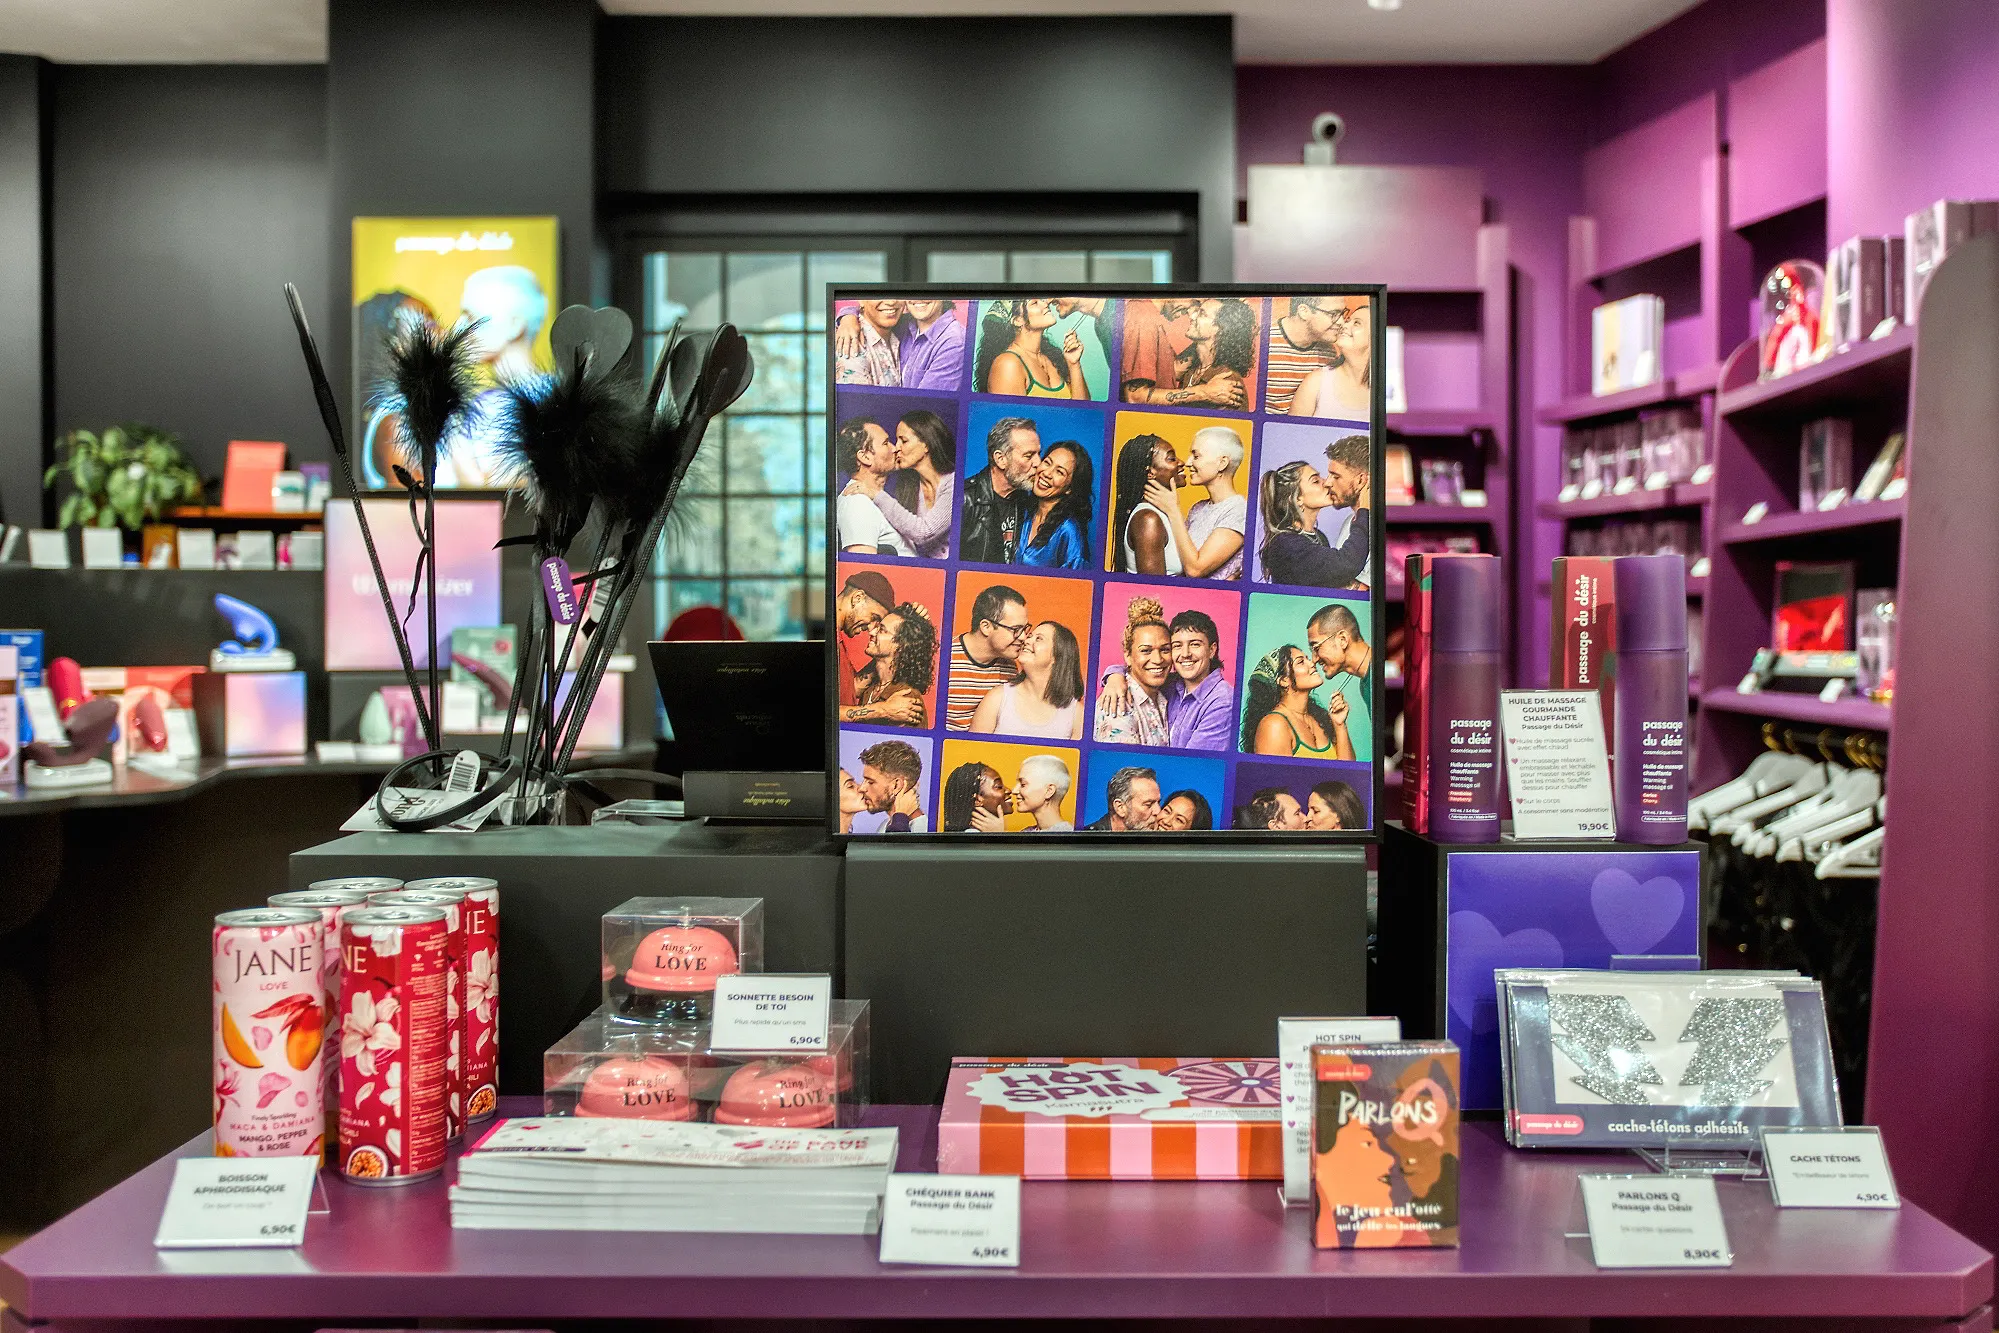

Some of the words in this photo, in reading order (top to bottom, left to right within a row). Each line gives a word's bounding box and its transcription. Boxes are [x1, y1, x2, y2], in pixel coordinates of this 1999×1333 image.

[546, 562, 563, 592] passage
[1574, 574, 1590, 606] désir
[557, 592, 570, 603] du
[560, 603, 575, 620] désir
[1573, 610, 1589, 627] du
[1579, 631, 1593, 684] passage
[1523, 714, 1577, 722] CHAUFFANTE
[1450, 720, 1492, 730] passage
[1643, 721, 1683, 732] passage
[1450, 732, 1464, 745] du
[1468, 732, 1492, 745] désir
[1643, 733, 1657, 746] du
[1661, 733, 1683, 746] désir
[1578, 823, 1609, 831] 19,90€
[661, 943, 685, 954] Ring
[234, 945, 312, 983] JANE
[655, 955, 707, 970] LOVE
[260, 981, 289, 991] LOVE
[790, 1036, 821, 1045] 6,90€
[627, 1077, 652, 1088] Ring
[999, 1069, 1123, 1088] HOT
[624, 1088, 676, 1106] LOVE
[1002, 1082, 1161, 1102] SPIN
[779, 1088, 825, 1108] LOVE
[1044, 1099, 1145, 1108] Kamasutra
[1338, 1091, 1437, 1126] PARLONS
[262, 1123, 268, 1131] &
[273, 1116, 315, 1129] DAMIANA
[1608, 1119, 1691, 1133] cache-tétons
[1694, 1119, 1749, 1134] adhésifs
[277, 1129, 307, 1140] PEPPER
[267, 1142, 291, 1151] ROSE
[1790, 1155, 1822, 1163] CACHE
[1824, 1154, 1861, 1163] TÉTONS
[218, 1174, 268, 1183] BOISSON
[194, 1184, 286, 1194] APHRODISIAQUE
[905, 1187, 961, 1199] CHÉQUIER
[965, 1190, 995, 1198] BANK
[1618, 1192, 1668, 1201] PARLONS
[1671, 1192, 1680, 1202] Q
[1856, 1193, 1888, 1202] 4,90€
[911, 1200, 950, 1210] Passage
[953, 1200, 965, 1209] du
[968, 1201, 993, 1210] Désir
[1612, 1203, 1650, 1212] Passage
[1668, 1204, 1693, 1212] Désir
[1336, 1204, 1350, 1216] le
[1349, 1203, 1381, 1221] jeu
[260, 1224, 296, 1235] 6,90€
[1336, 1222, 1351, 1232] qui
[1399, 1221, 1441, 1232] langues
[972, 1247, 1009, 1258] 4,90€
[1684, 1249, 1719, 1259] 8,90€
